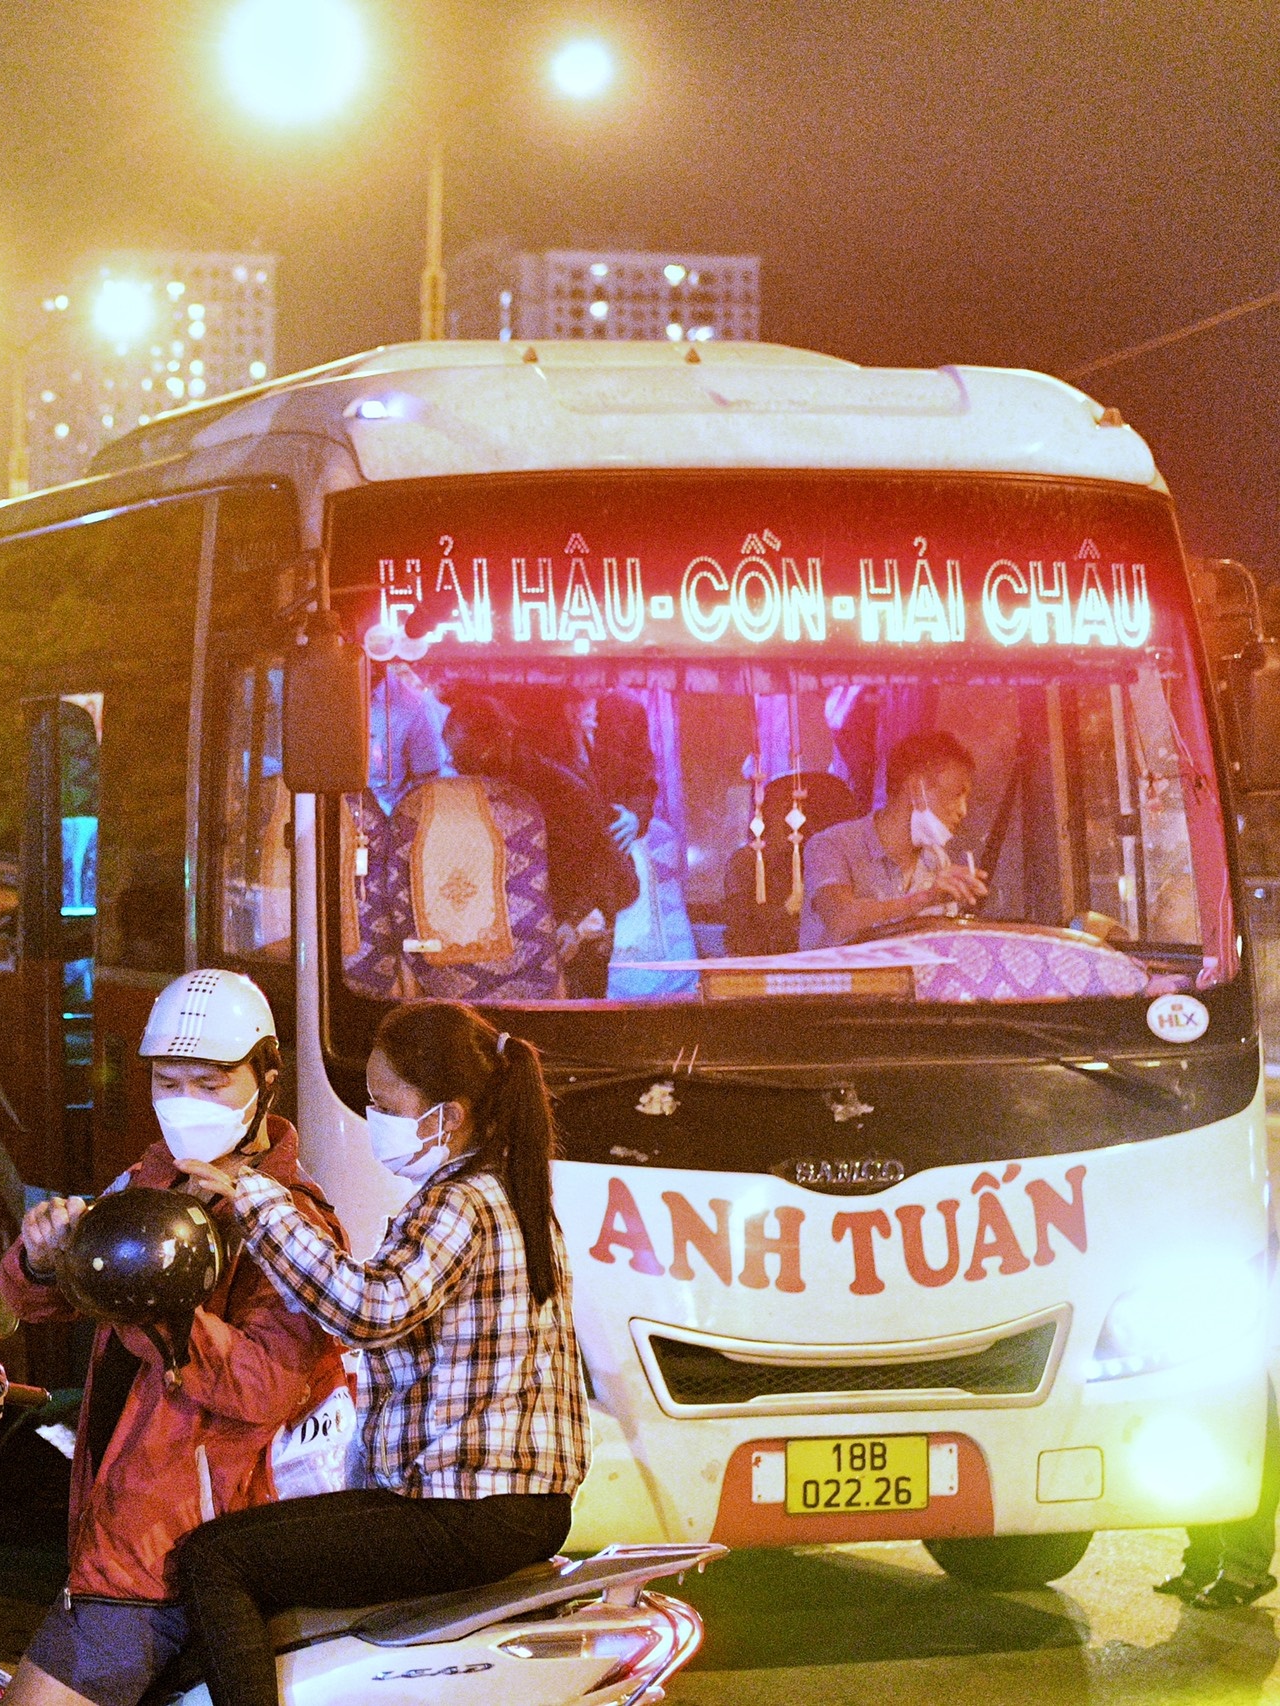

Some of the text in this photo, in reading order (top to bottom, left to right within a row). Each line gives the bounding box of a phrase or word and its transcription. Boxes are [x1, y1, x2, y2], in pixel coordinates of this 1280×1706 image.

[379, 534, 492, 643] HẢI
[982, 538, 1151, 647] CHÂU
[1157, 1013, 1198, 1029] HLX
[589, 1163, 1089, 1296] ANH TUẤN
[832, 1441, 888, 1473] 18B
[802, 1476, 912, 1508] 022.26
